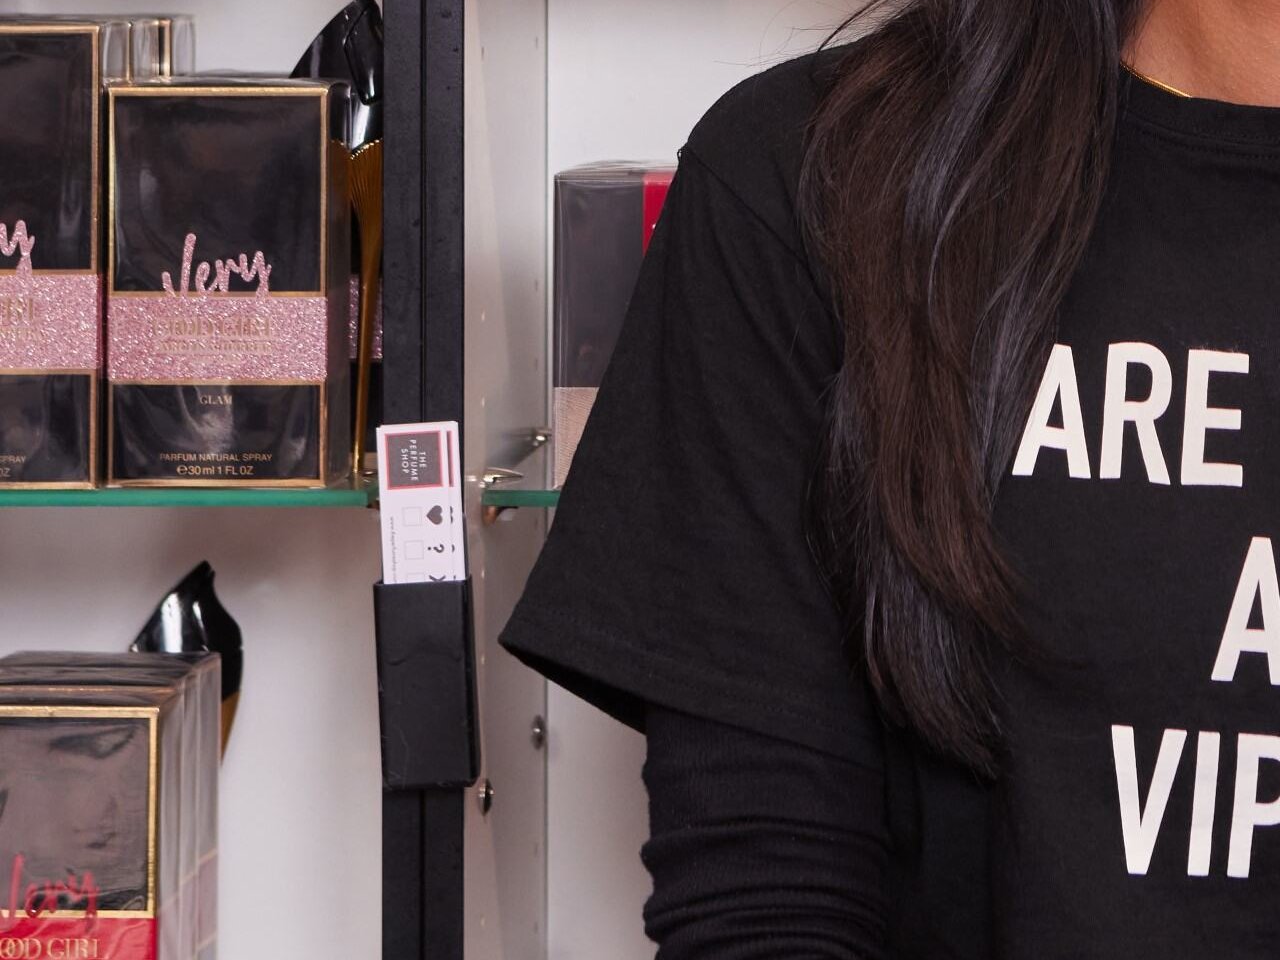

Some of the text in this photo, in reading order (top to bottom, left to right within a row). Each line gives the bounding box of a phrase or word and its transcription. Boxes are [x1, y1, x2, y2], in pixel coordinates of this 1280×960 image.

[200, 395, 233, 406] GLAM
[1012, 342, 1249, 487] ARE
[160, 453, 273, 462] PARFUM NATURAL SPRAY
[401, 448, 409, 474] SHOP
[410, 439, 418, 481] PERFUME
[419, 451, 428, 468] THE
[225, 465, 238, 474] FL
[240, 465, 254, 474] OZ
